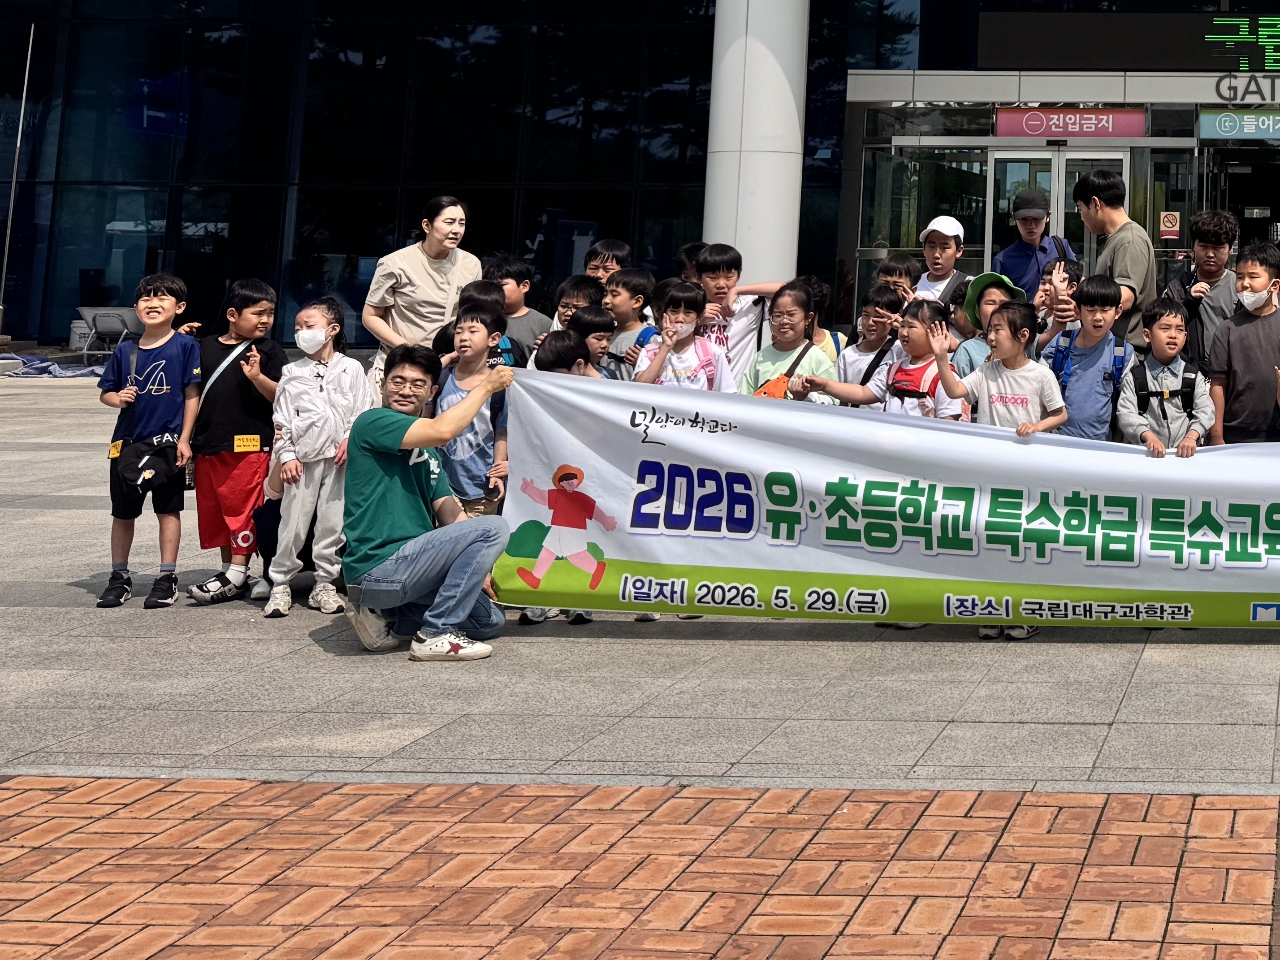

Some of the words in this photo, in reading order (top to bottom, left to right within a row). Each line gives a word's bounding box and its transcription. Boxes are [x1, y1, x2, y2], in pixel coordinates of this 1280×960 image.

[1048, 114, 1113, 133] 진입금지
[630, 460, 755, 534] 2026
[986, 489, 1138, 561] 특수학급
[697, 584, 763, 608] 2026.
[773, 589, 796, 610] 5.
[1021, 600, 1191, 620] 국립대구과학관
